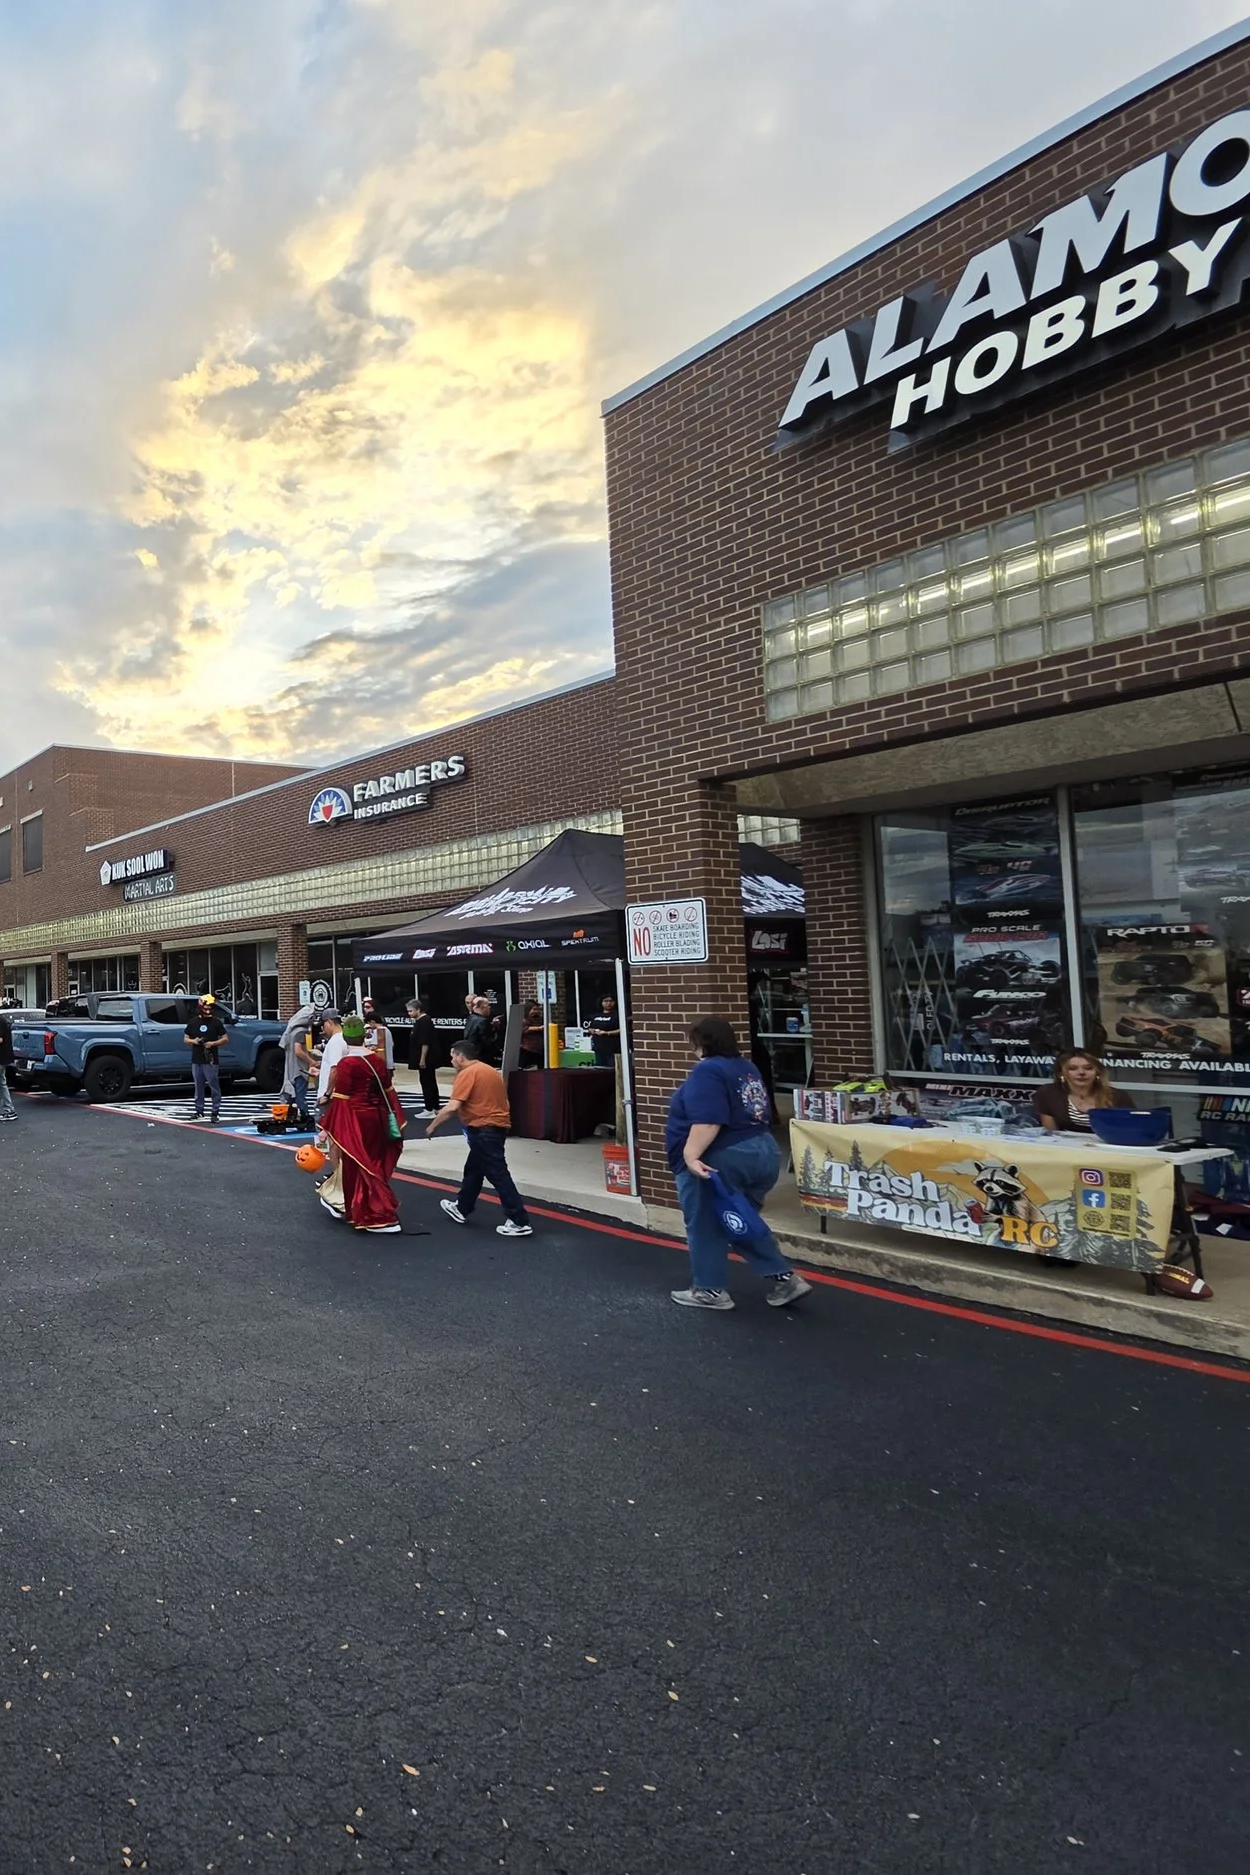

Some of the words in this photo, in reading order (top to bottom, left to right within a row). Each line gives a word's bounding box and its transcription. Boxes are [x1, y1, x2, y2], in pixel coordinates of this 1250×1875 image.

[778, 109, 1250, 429] ALAMO
[890, 217, 1242, 430] HOBBY
[353, 755, 465, 802] FARMERS
[354, 792, 428, 819] INSURANCE
[112, 860, 126, 880] KUK
[127, 855, 145, 877] SOOL
[145, 849, 164, 872] WON
[124, 882, 154, 900] MARTIAL
[155, 875, 174, 894] ARTS
[653, 925, 669, 933] SKATE
[670, 922, 699, 932] BOARDING
[653, 932, 677, 940] BICYCLE
[678, 930, 700, 939] RIDING
[971, 926, 997, 934] PRO
[1000, 924, 1042, 933] SCALE
[561, 936, 599, 946] SPEKTRUM
[633, 926, 651, 957] NO
[654, 940, 675, 948] ROLLER
[676, 938, 701, 947] BLADING
[654, 948, 679, 956] SCOOTER
[680, 947, 701, 955] RIDING
[943, 1052, 1000, 1065] RENTALS,
[1004, 1054, 1056, 1065] LAYAWA
[1100, 1058, 1171, 1070] NANCING
[949, 1084, 1038, 1101] MAXX
[823, 1160, 943, 1202] Trash
[845, 1188, 982, 1237] Panda
[1001, 1215, 1060, 1249] RC
